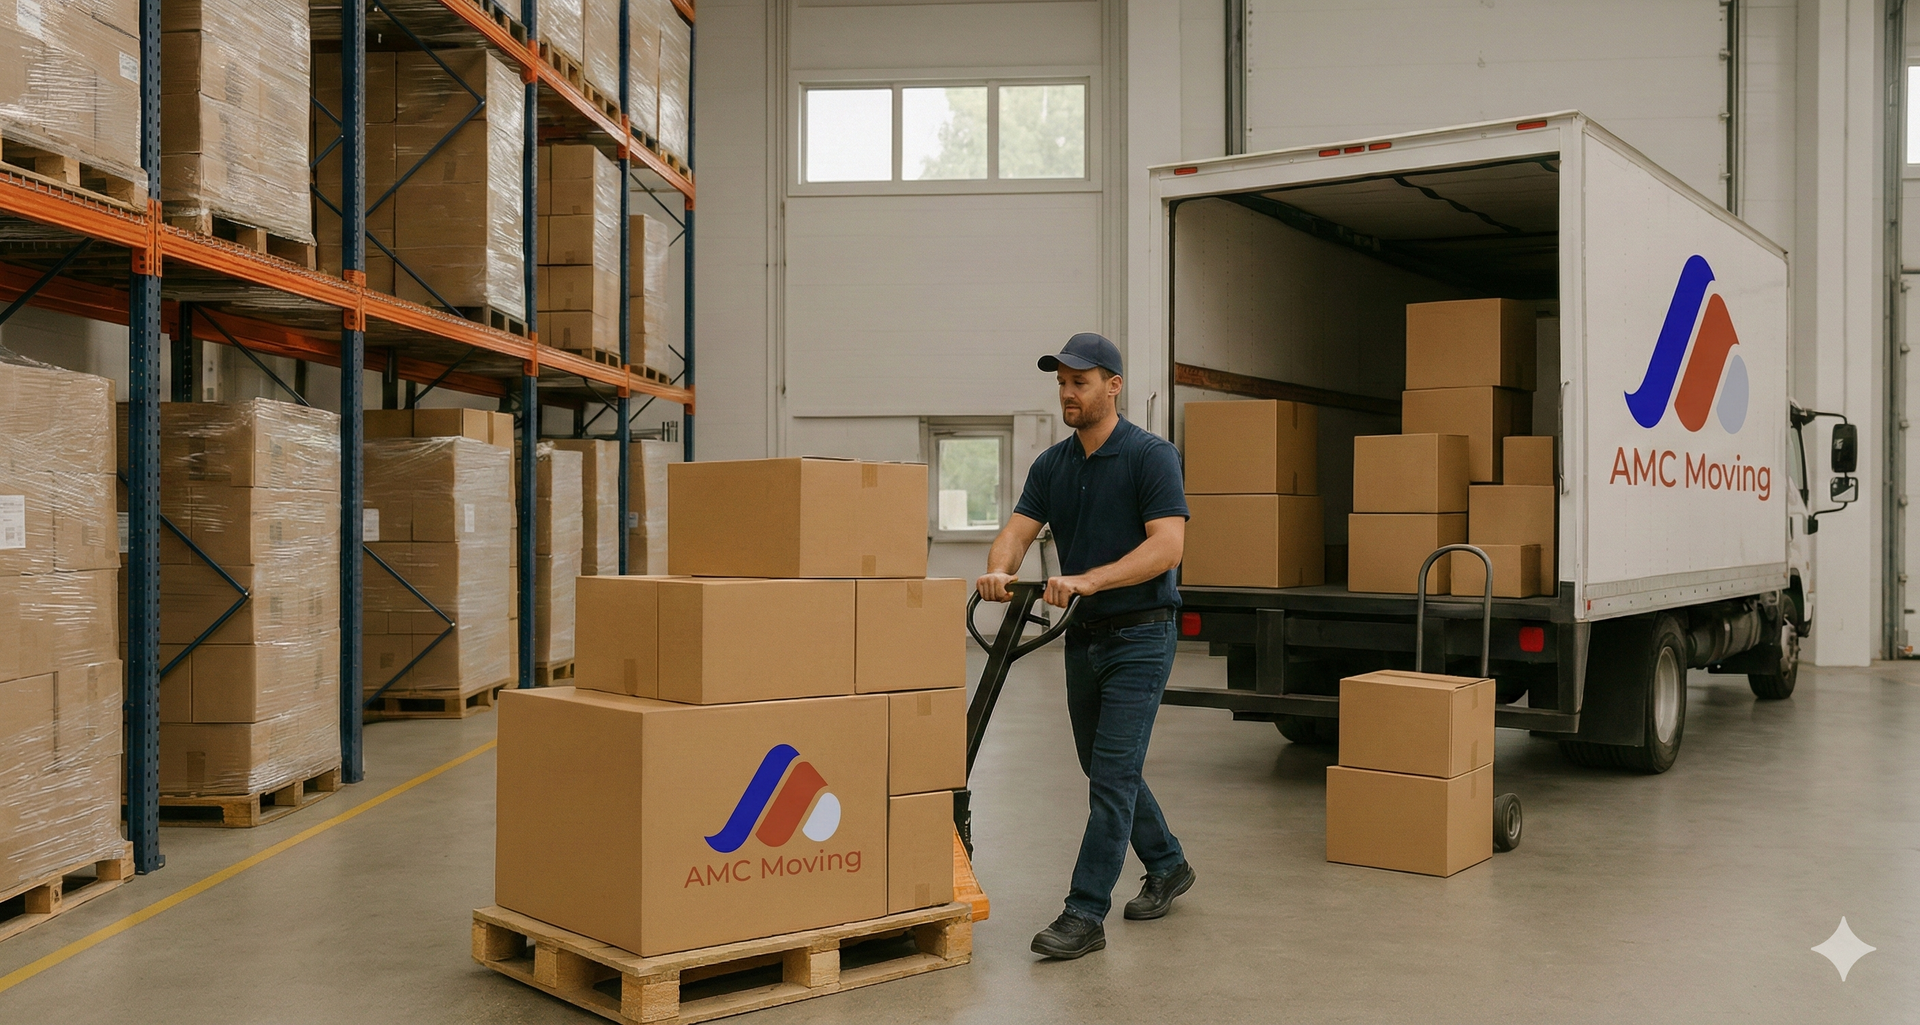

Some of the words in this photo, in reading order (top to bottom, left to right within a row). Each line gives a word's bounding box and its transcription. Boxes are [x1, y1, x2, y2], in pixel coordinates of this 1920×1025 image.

[1609, 446, 1677, 488] AMC
[1685, 452, 1771, 502] Moving
[684, 859, 751, 888] AMC
[761, 849, 862, 879] Moving
